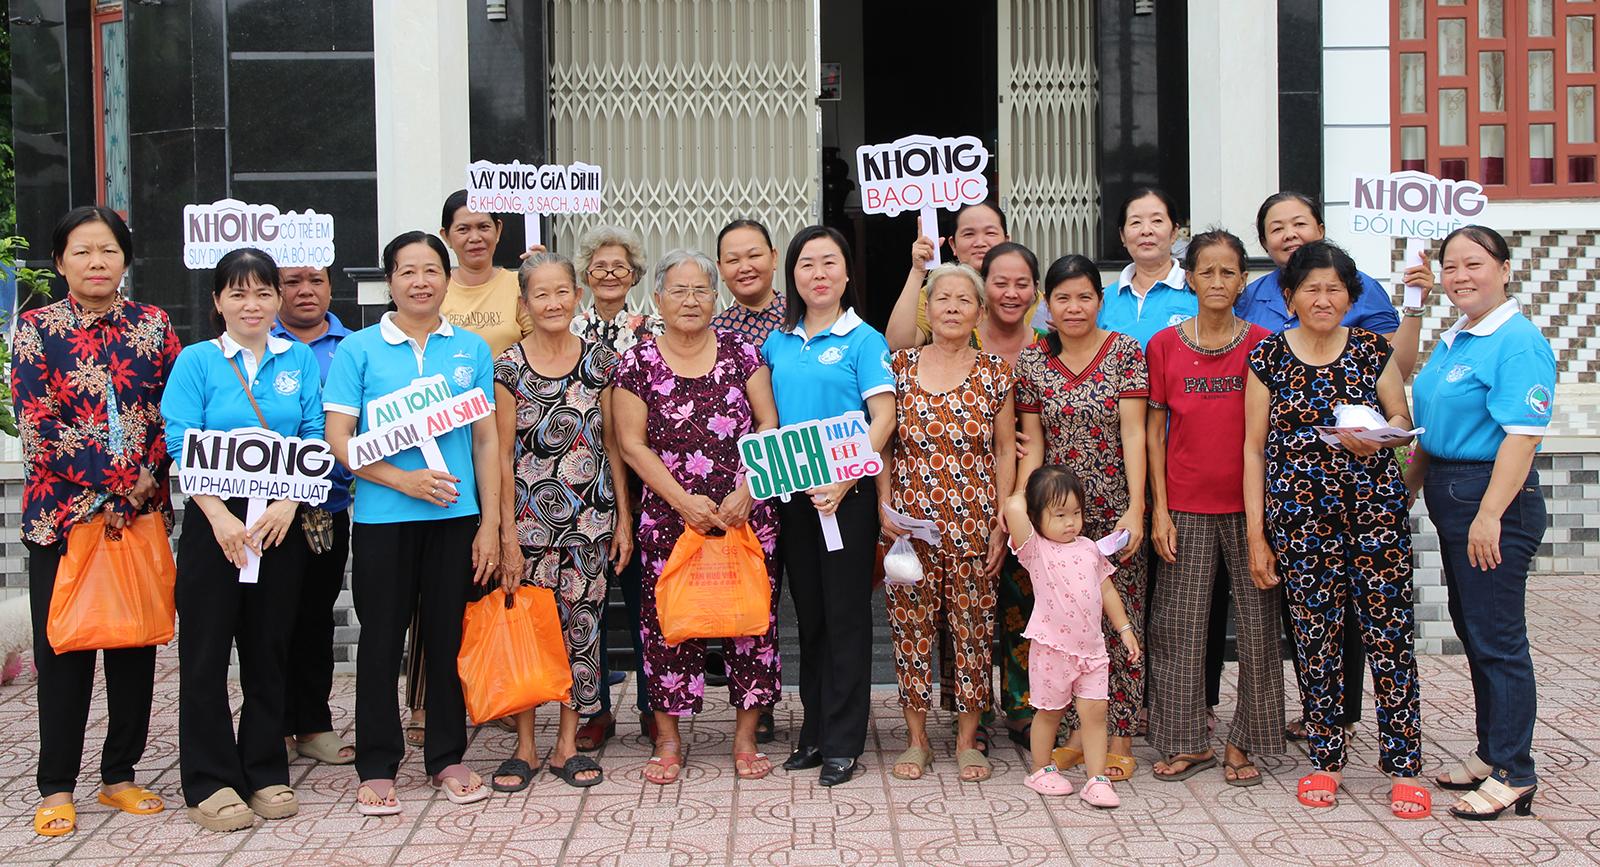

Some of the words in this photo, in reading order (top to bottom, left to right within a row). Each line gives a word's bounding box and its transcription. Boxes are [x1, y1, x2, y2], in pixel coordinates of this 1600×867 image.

[863, 142, 981, 181] KHÔNG
[470, 167, 495, 189] XÂY
[470, 197, 477, 211] 5
[480, 193, 524, 212] KHÔNG,
[528, 197, 535, 211] 3
[537, 197, 570, 214] SẠCH,
[573, 197, 580, 211] 3
[583, 197, 599, 211] AN
[867, 184, 923, 212] BẠO
[932, 178, 981, 206] LỰC
[1355, 176, 1485, 217] KHÔNG
[189, 207, 279, 242] KHÔNG
[280, 219, 296, 239] CÓ
[299, 217, 313, 239] TRẺ
[316, 223, 330, 239] EM
[1354, 213, 1393, 235] ĐÓI
[189, 248, 207, 265] SUY
[275, 244, 288, 263] VÀ
[291, 242, 305, 263] BỎ
[308, 246, 331, 266] HỌC
[1184, 376, 1243, 393] PARIS
[375, 401, 402, 427] AN
[356, 439, 383, 466] AN
[427, 409, 453, 436] AN
[826, 417, 866, 441] NHÀ
[186, 432, 330, 477] KHÔNG
[742, 425, 832, 501] SẠCH
[184, 475, 197, 491] VI
[200, 477, 245, 497] PHẠM
[249, 476, 290, 497] PHÁP
